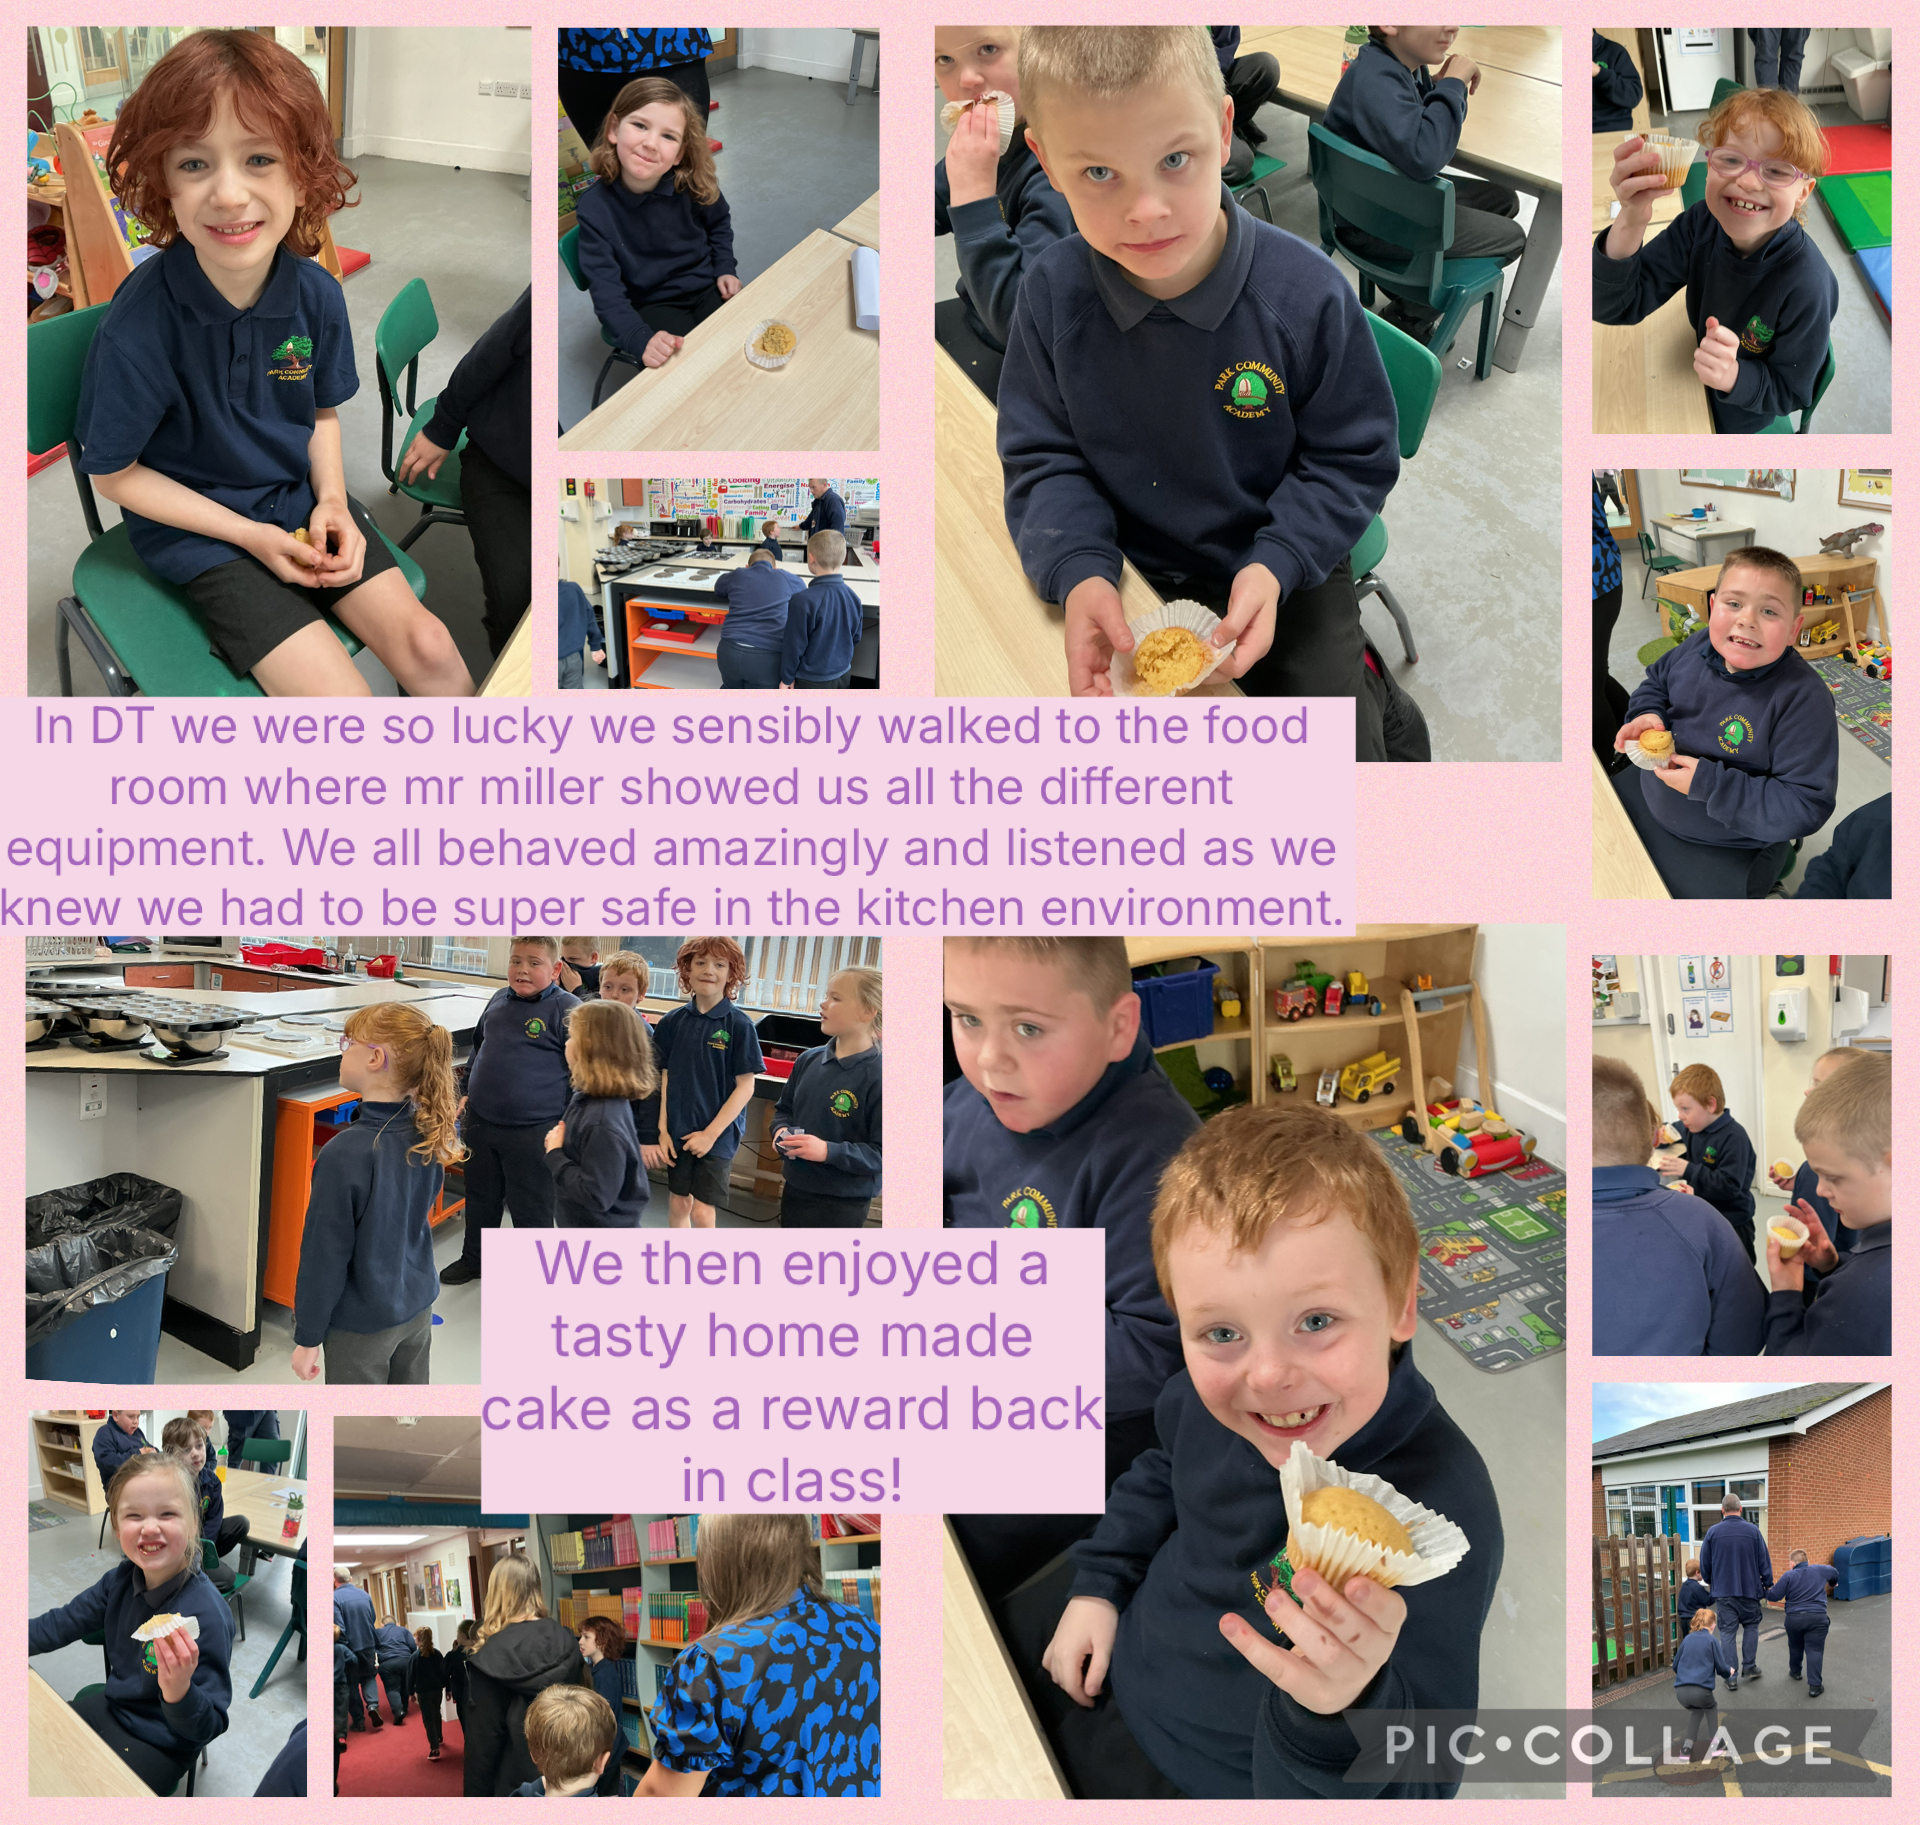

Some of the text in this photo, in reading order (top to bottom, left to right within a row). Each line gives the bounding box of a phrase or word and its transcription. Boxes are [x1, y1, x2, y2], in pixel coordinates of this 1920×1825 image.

[1214, 360, 1286, 395] PARK COMMUNITY
[1223, 404, 1271, 418] ACADEMY
[1719, 714, 1754, 744] PARK COMMUNITY
[1718, 736, 1739, 754] ACADEMY
[1002, 1188, 1022, 1209] PARK
